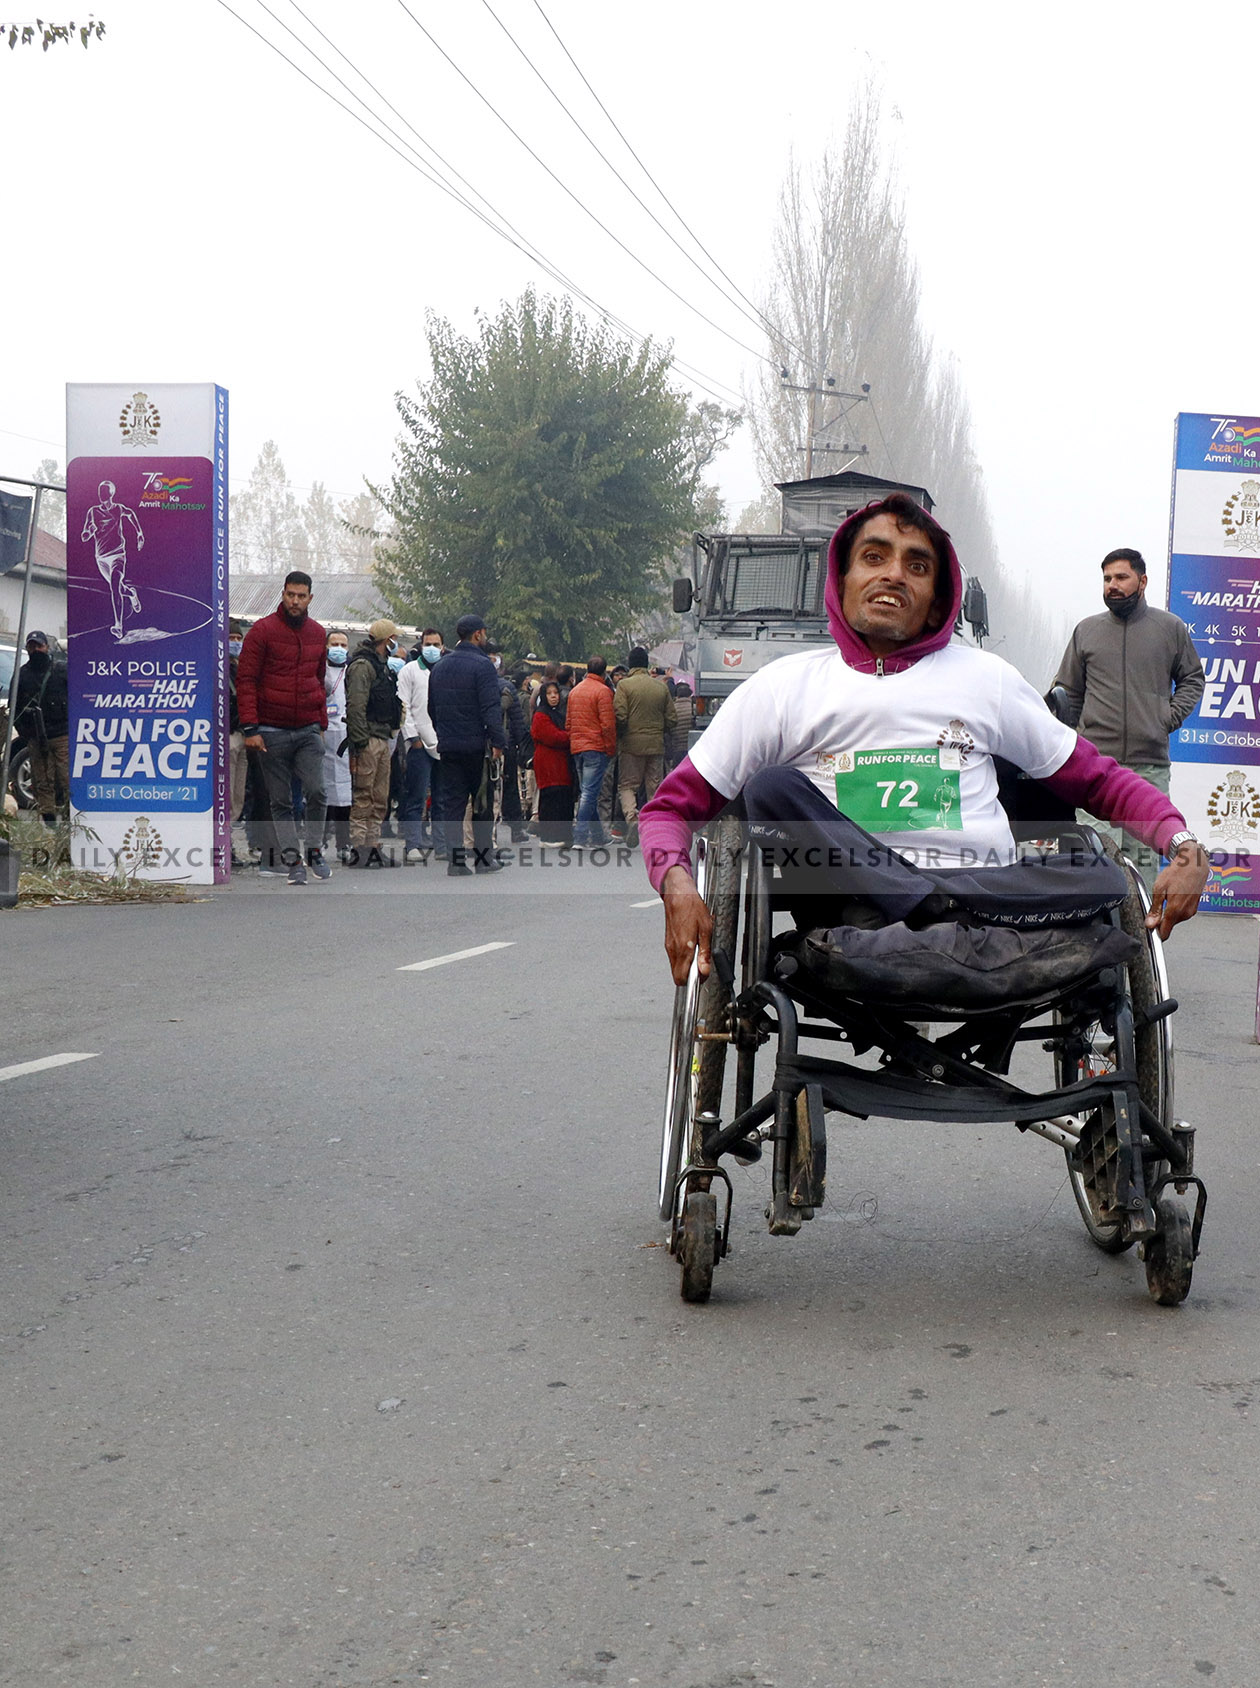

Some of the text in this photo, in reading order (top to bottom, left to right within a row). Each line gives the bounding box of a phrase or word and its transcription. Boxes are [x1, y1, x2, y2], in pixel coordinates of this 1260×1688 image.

[1203, 453, 1232, 463] Amrit
[1209, 442, 1257, 458] Azadi Ka
[142, 491, 180, 503] Azadi Ka
[161, 502, 206, 511] Mahotsav
[218, 527, 226, 591] POLICE
[218, 600, 226, 631] J&K
[1205, 624, 1220, 635] 4K
[1231, 626, 1247, 637] 5K
[87, 661, 197, 677] J&K POLICE
[218, 639, 226, 691] PEACE
[1200, 658, 1246, 683] UN
[152, 679, 199, 694] HALF
[94, 694, 197, 709] MARATHON
[218, 694, 226, 728] FOR
[76, 718, 211, 743] RUN FOR
[1181, 729, 1209, 744] 31st
[218, 732, 226, 768] RUN
[72, 743, 211, 779] PEACE
[88, 785, 116, 799] 31st
[119, 785, 174, 801] October
[876, 780, 919, 808] 72
[218, 775, 226, 836] POLICE
[1222, 888, 1234, 896] Ka
[1025, 913, 1039, 924] NIKE
